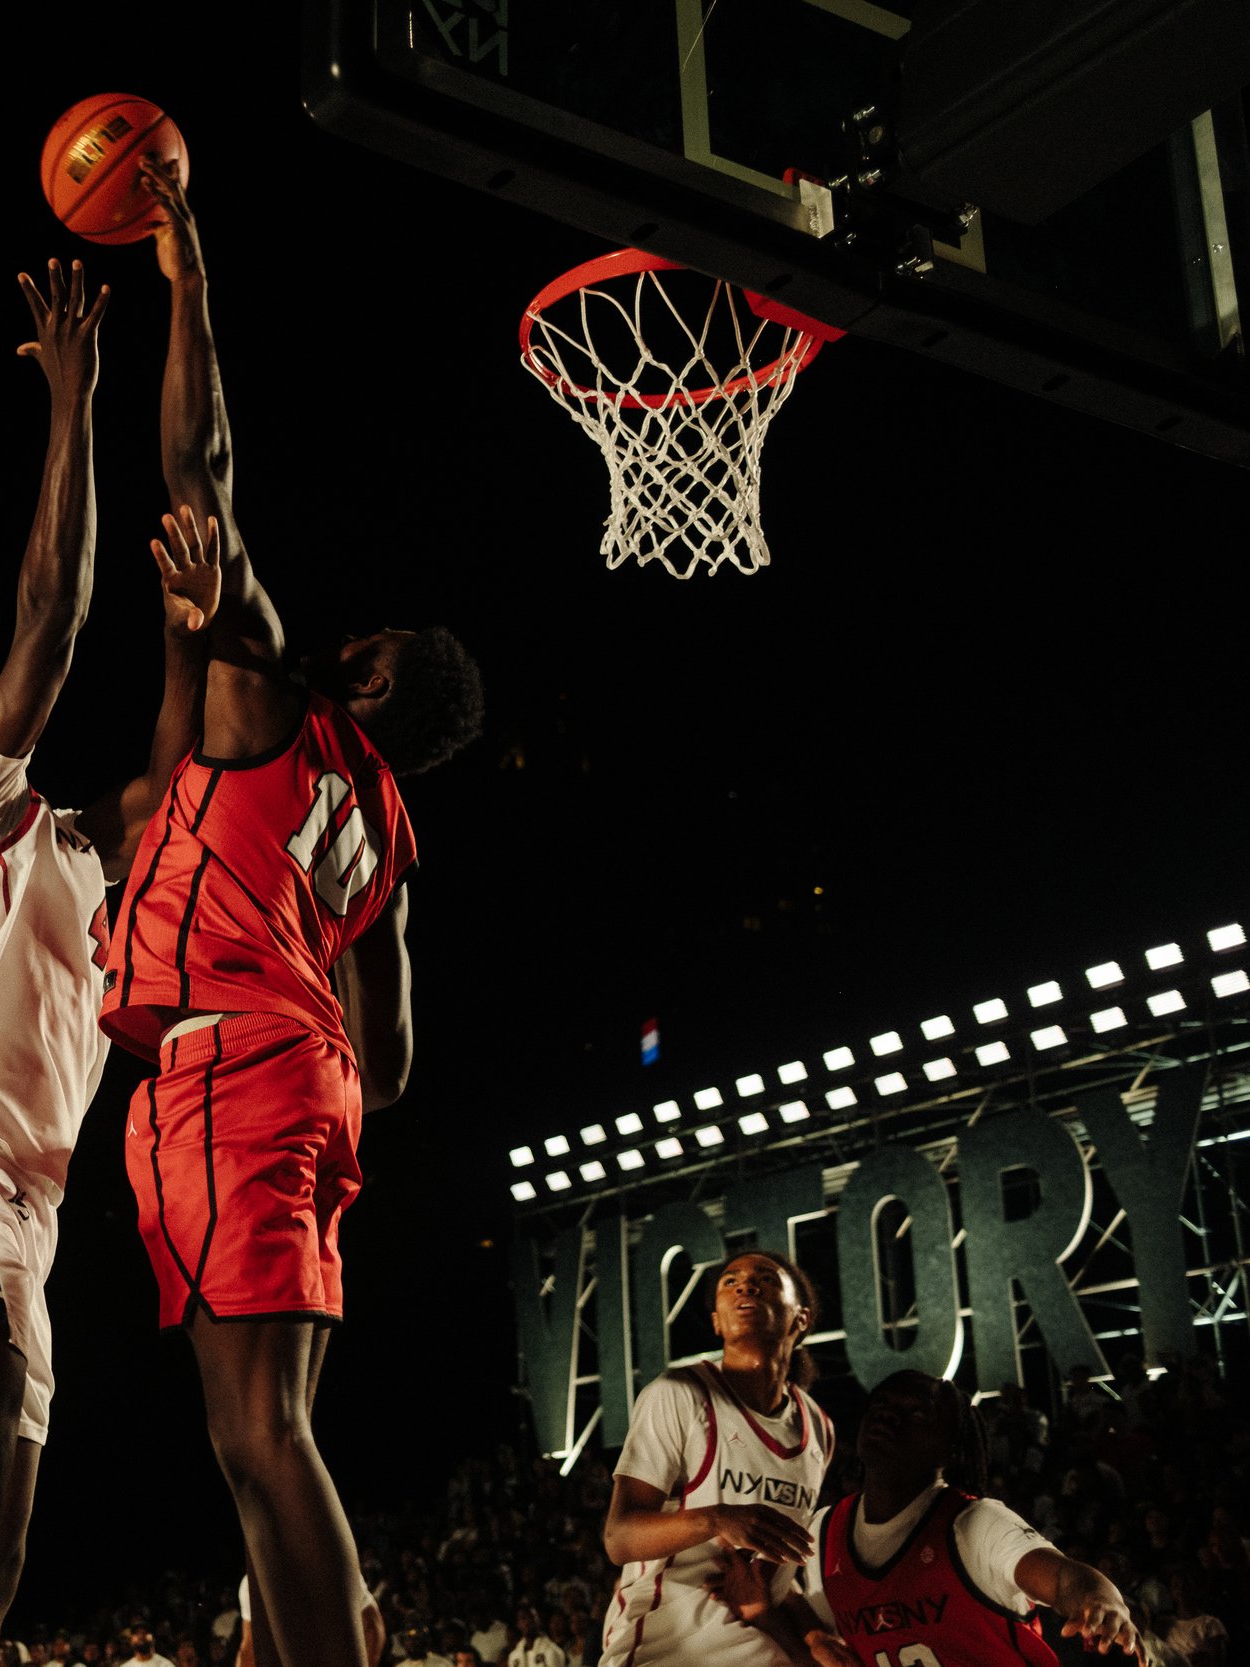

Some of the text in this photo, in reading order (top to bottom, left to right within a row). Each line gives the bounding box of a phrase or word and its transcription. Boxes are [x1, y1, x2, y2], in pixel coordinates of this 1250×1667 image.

[286, 769, 384, 917] 10
[507, 1062, 1216, 1458] VICTORY
[720, 1469, 762, 1494] NY
[764, 1478, 797, 1506] VS
